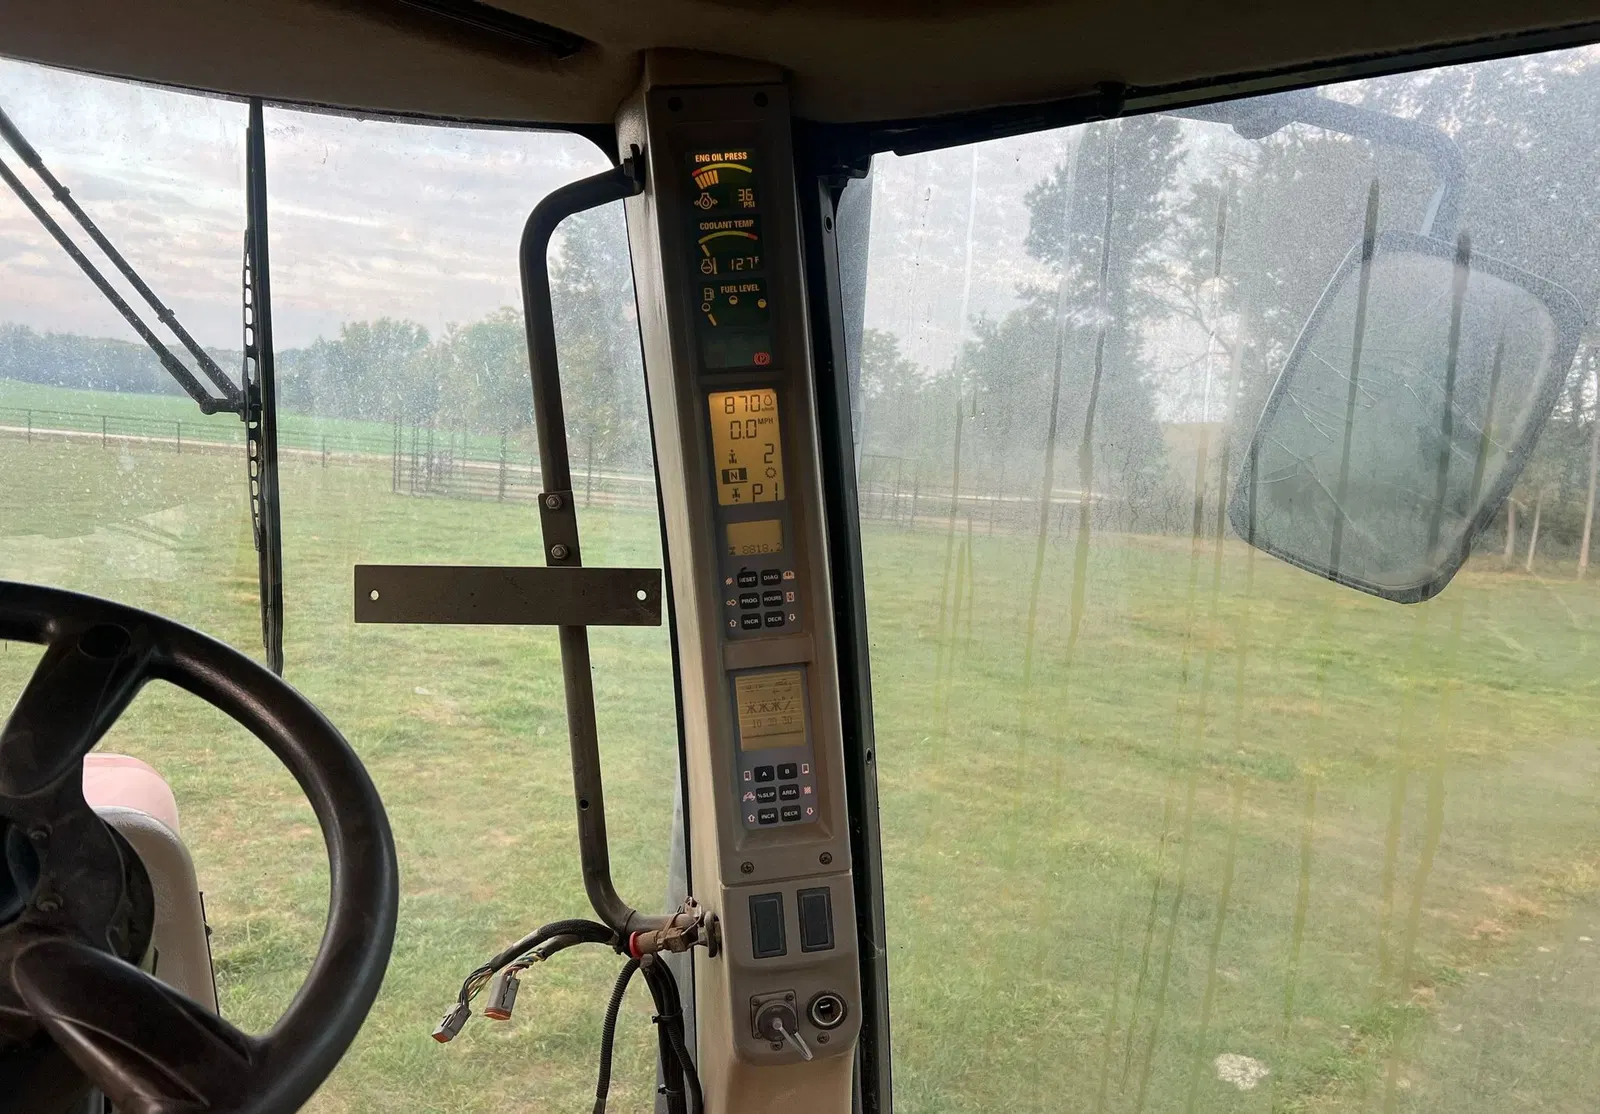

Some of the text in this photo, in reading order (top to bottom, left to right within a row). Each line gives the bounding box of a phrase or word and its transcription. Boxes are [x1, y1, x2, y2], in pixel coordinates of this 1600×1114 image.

[695, 151, 748, 163] ENG OIL PRESS
[738, 188, 753, 202] 36
[700, 220, 754, 230] COOLANT TEMP
[739, 284, 760, 292] LEVEL
[724, 394, 760, 414] 870
[730, 419, 757, 440] 0.0
